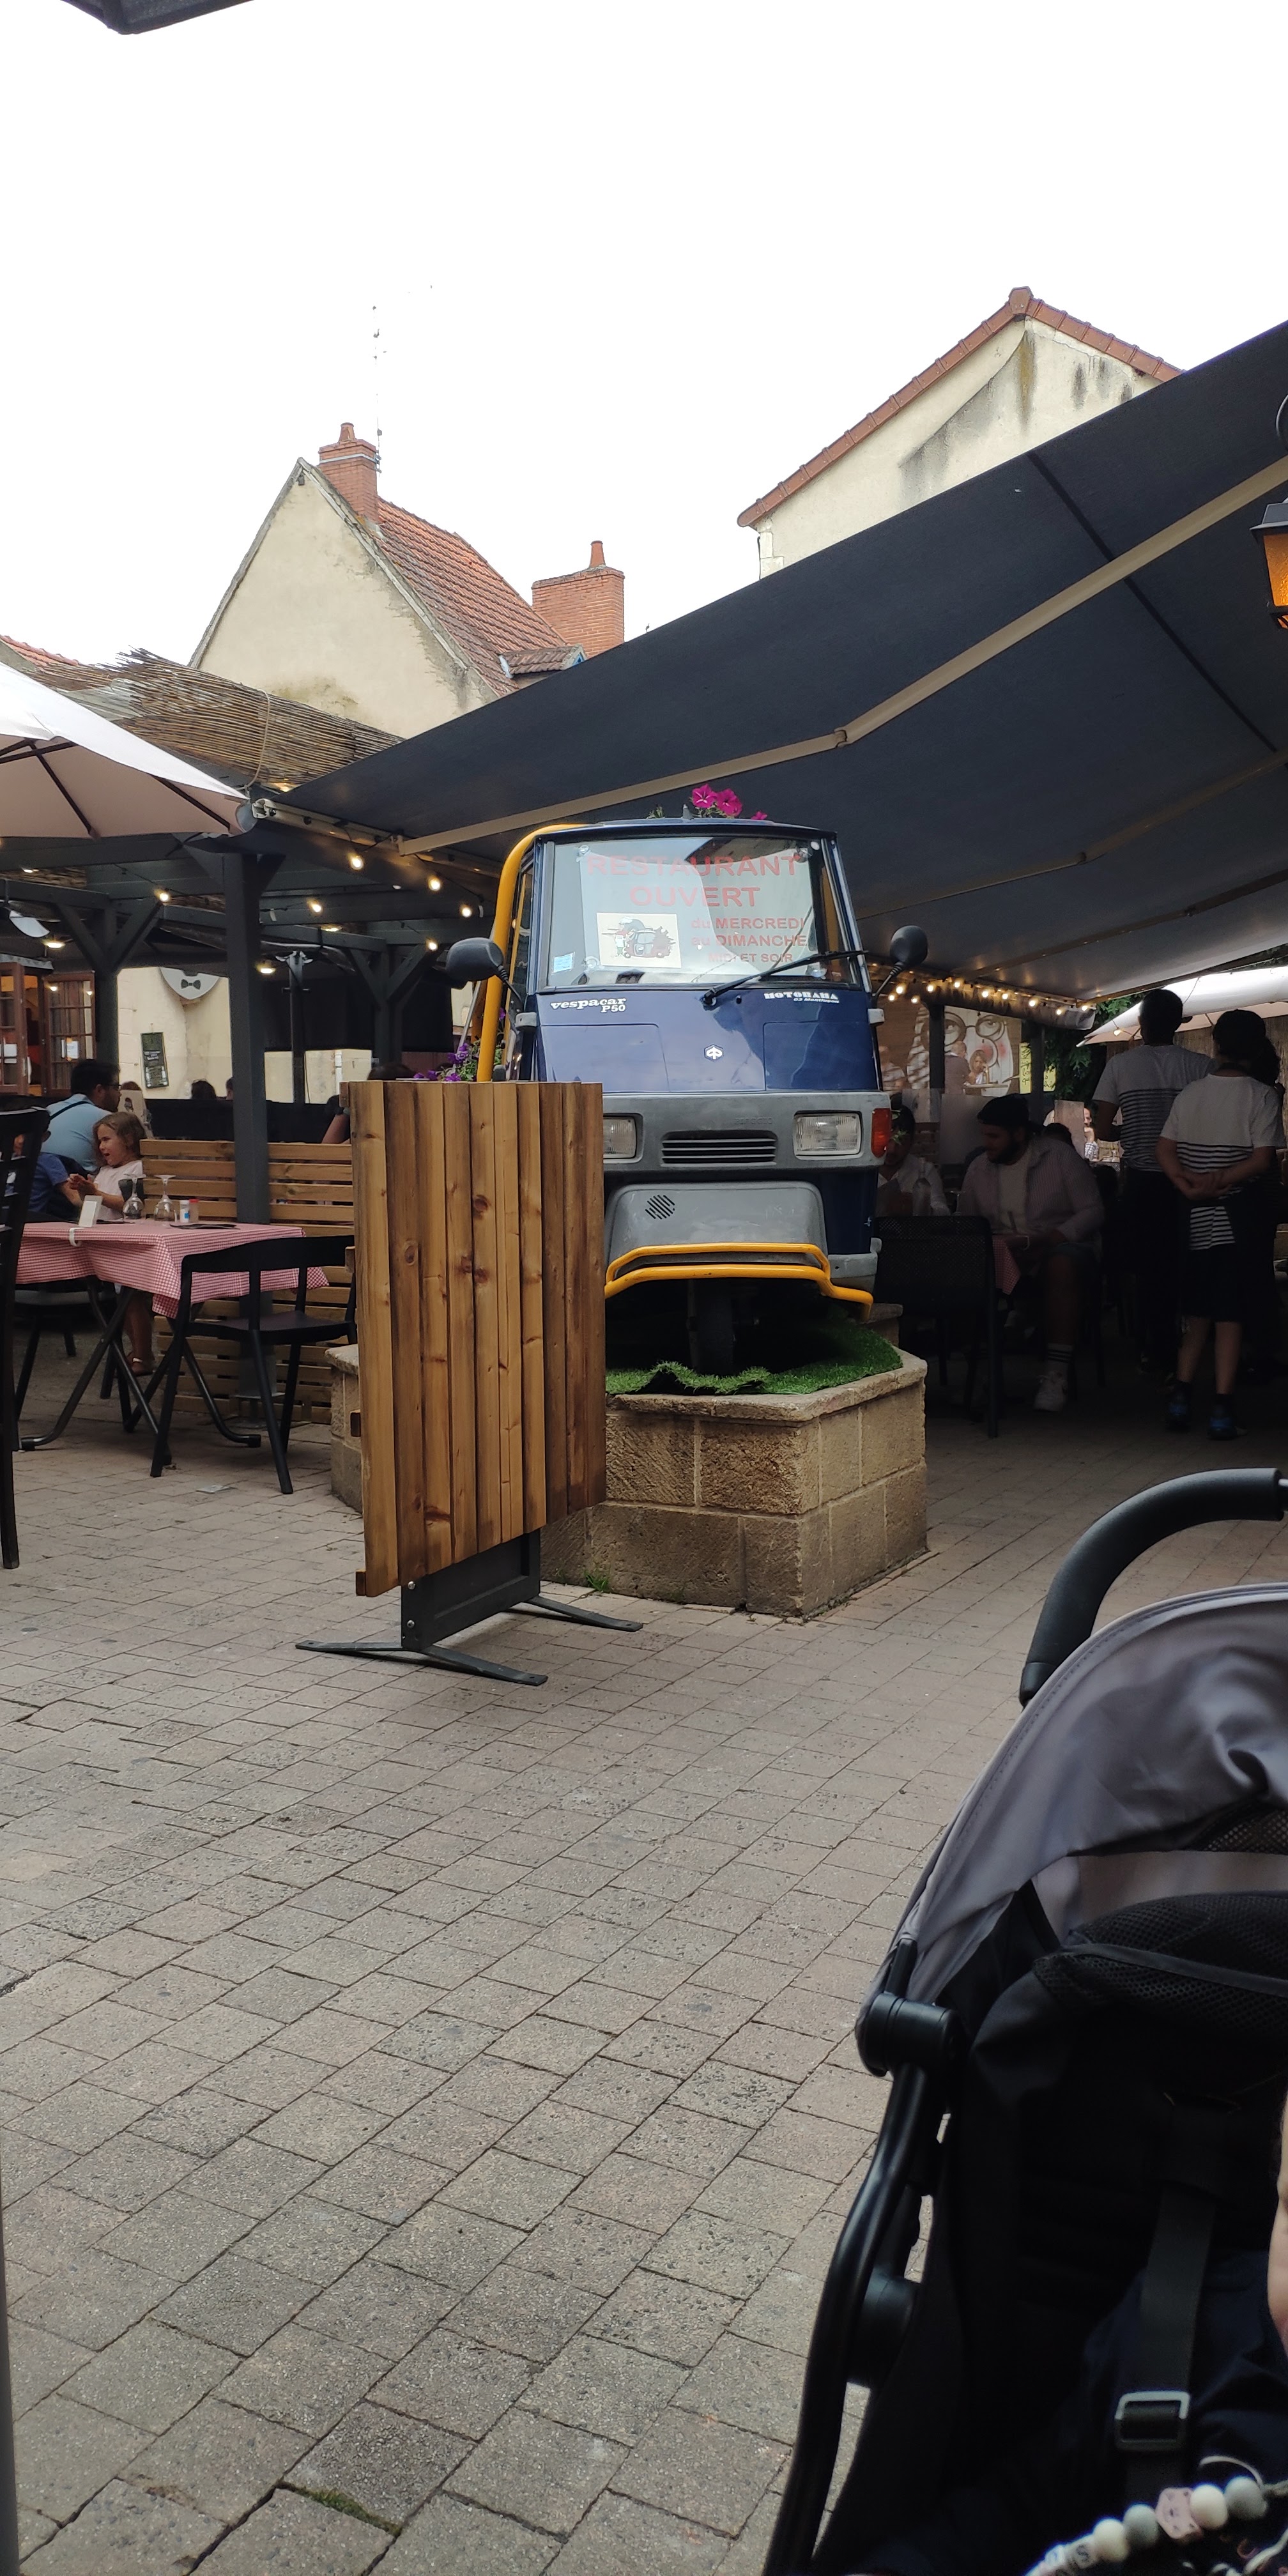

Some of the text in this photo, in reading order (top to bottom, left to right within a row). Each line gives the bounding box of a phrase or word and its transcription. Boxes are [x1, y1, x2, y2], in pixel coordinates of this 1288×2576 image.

[586, 855, 802, 876] RESTAURANT
[629, 886, 761, 907] OUVERT
[691, 917, 804, 929] du MERCREDI
[691, 935, 807, 947] au DIMANCHE
[740, 953, 757, 962] ET
[760, 953, 793, 963] SOIR
[763, 991, 839, 1000] MOTORAMA
[550, 997, 627, 1010] vespacar
[601, 1004, 626, 1013] P50
